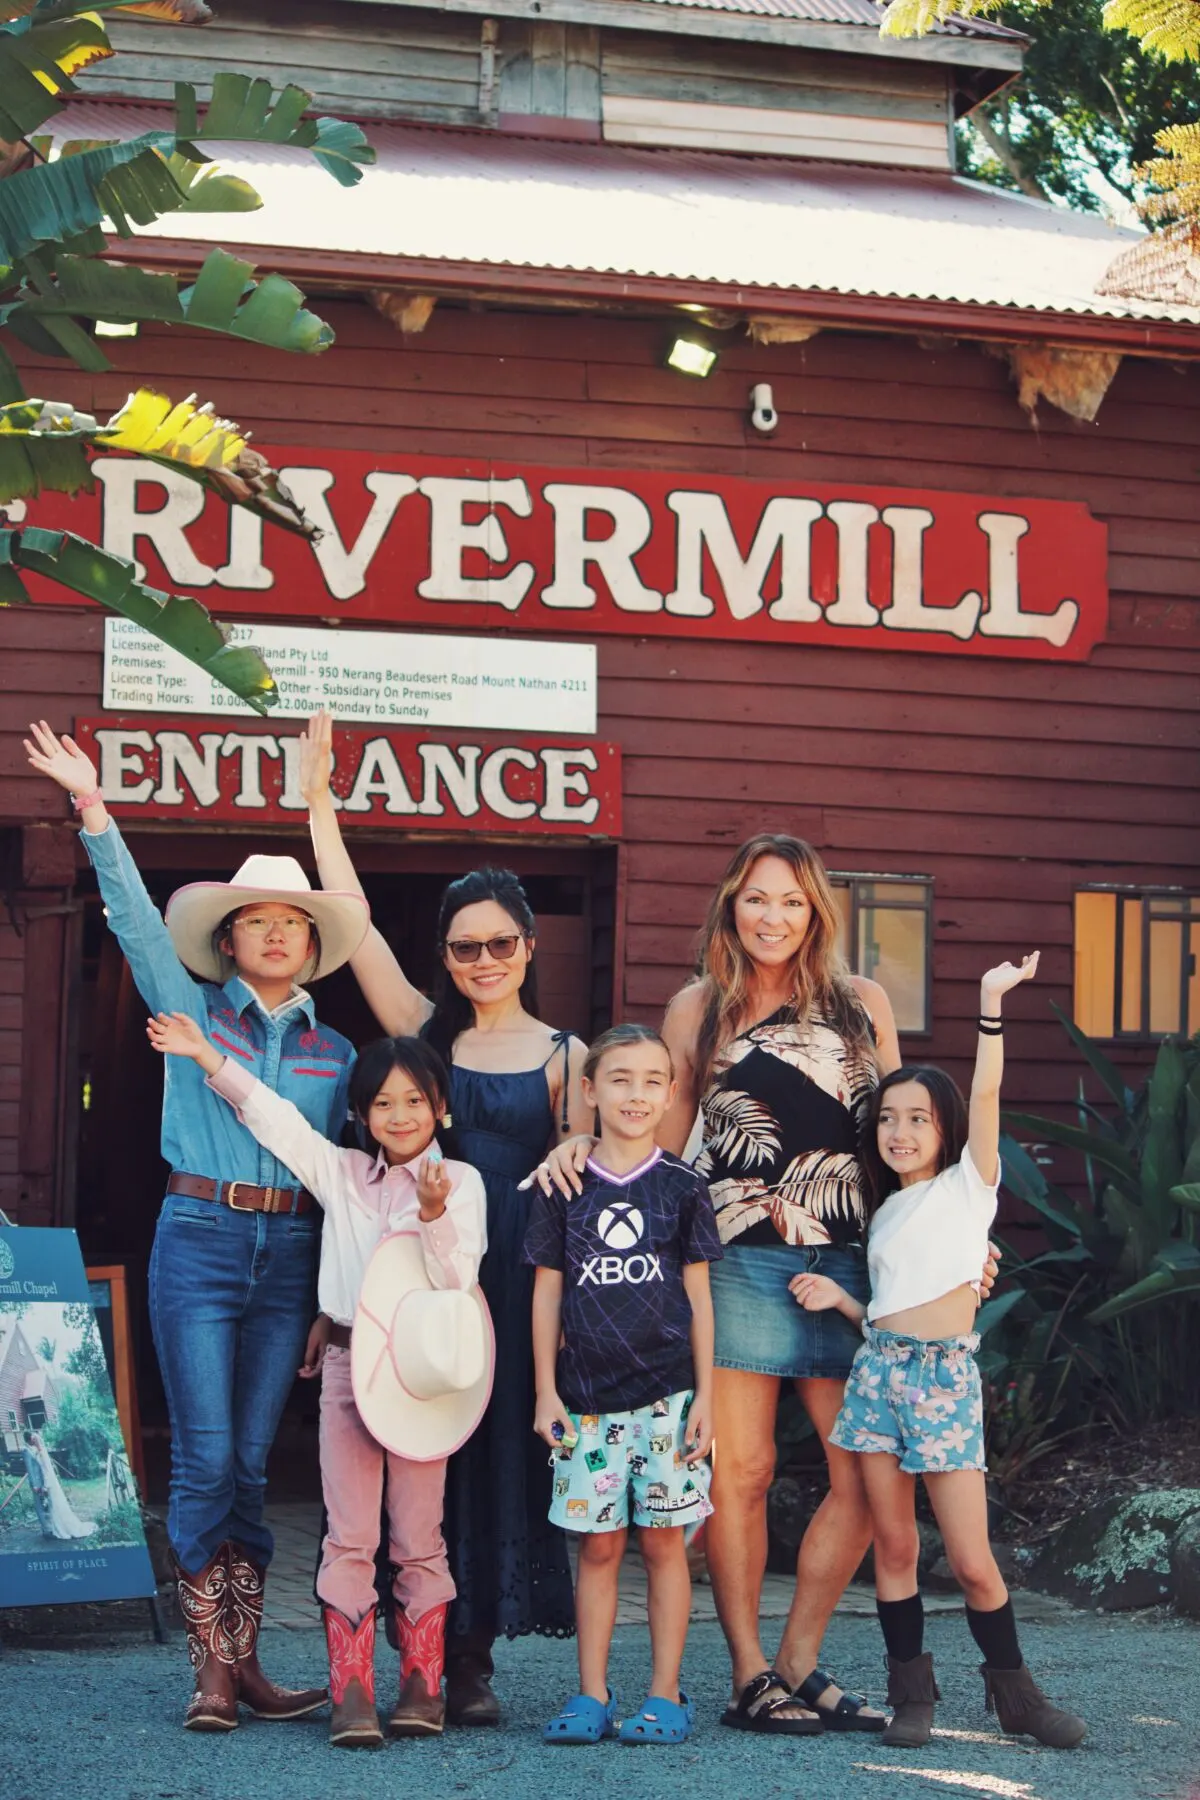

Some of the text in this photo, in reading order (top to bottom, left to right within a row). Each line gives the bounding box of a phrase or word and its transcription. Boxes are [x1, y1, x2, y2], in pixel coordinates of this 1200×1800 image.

[89, 456, 1080, 648] RIVERMILL
[112, 620, 151, 634] Licen
[112, 638, 164, 652] Licensee:
[290, 648, 307, 662] Pty
[311, 648, 328, 661] Ltd
[111, 655, 166, 669] Premises:
[269, 664, 307, 677] vermill
[318, 666, 339, 678] 950
[342, 668, 382, 683] Nerang
[386, 669, 447, 684] Beaudesert
[451, 673, 478, 686] Road
[482, 675, 515, 688] Mount
[519, 676, 557, 690] Nathan
[561, 679, 587, 692] 4211
[111, 671, 153, 685] Licence
[157, 673, 187, 688] Type:
[280, 681, 311, 694] Other
[322, 683, 380, 698] Subsidiary
[384, 686, 399, 698] On
[402, 687, 453, 701] Premises
[111, 688, 153, 704] Trading
[157, 691, 194, 704] Hours:
[211, 694, 248, 707] 10.00a
[278, 698, 325, 712] 12.00am
[329, 700, 371, 715] Monday
[375, 703, 386, 714] to
[389, 703, 429, 719] Sunday
[577, 1253, 664, 1286] XBOX
[23, 1280, 58, 1298] Chapel
[27, 1558, 109, 1571] SPIRIT OF PLACE
